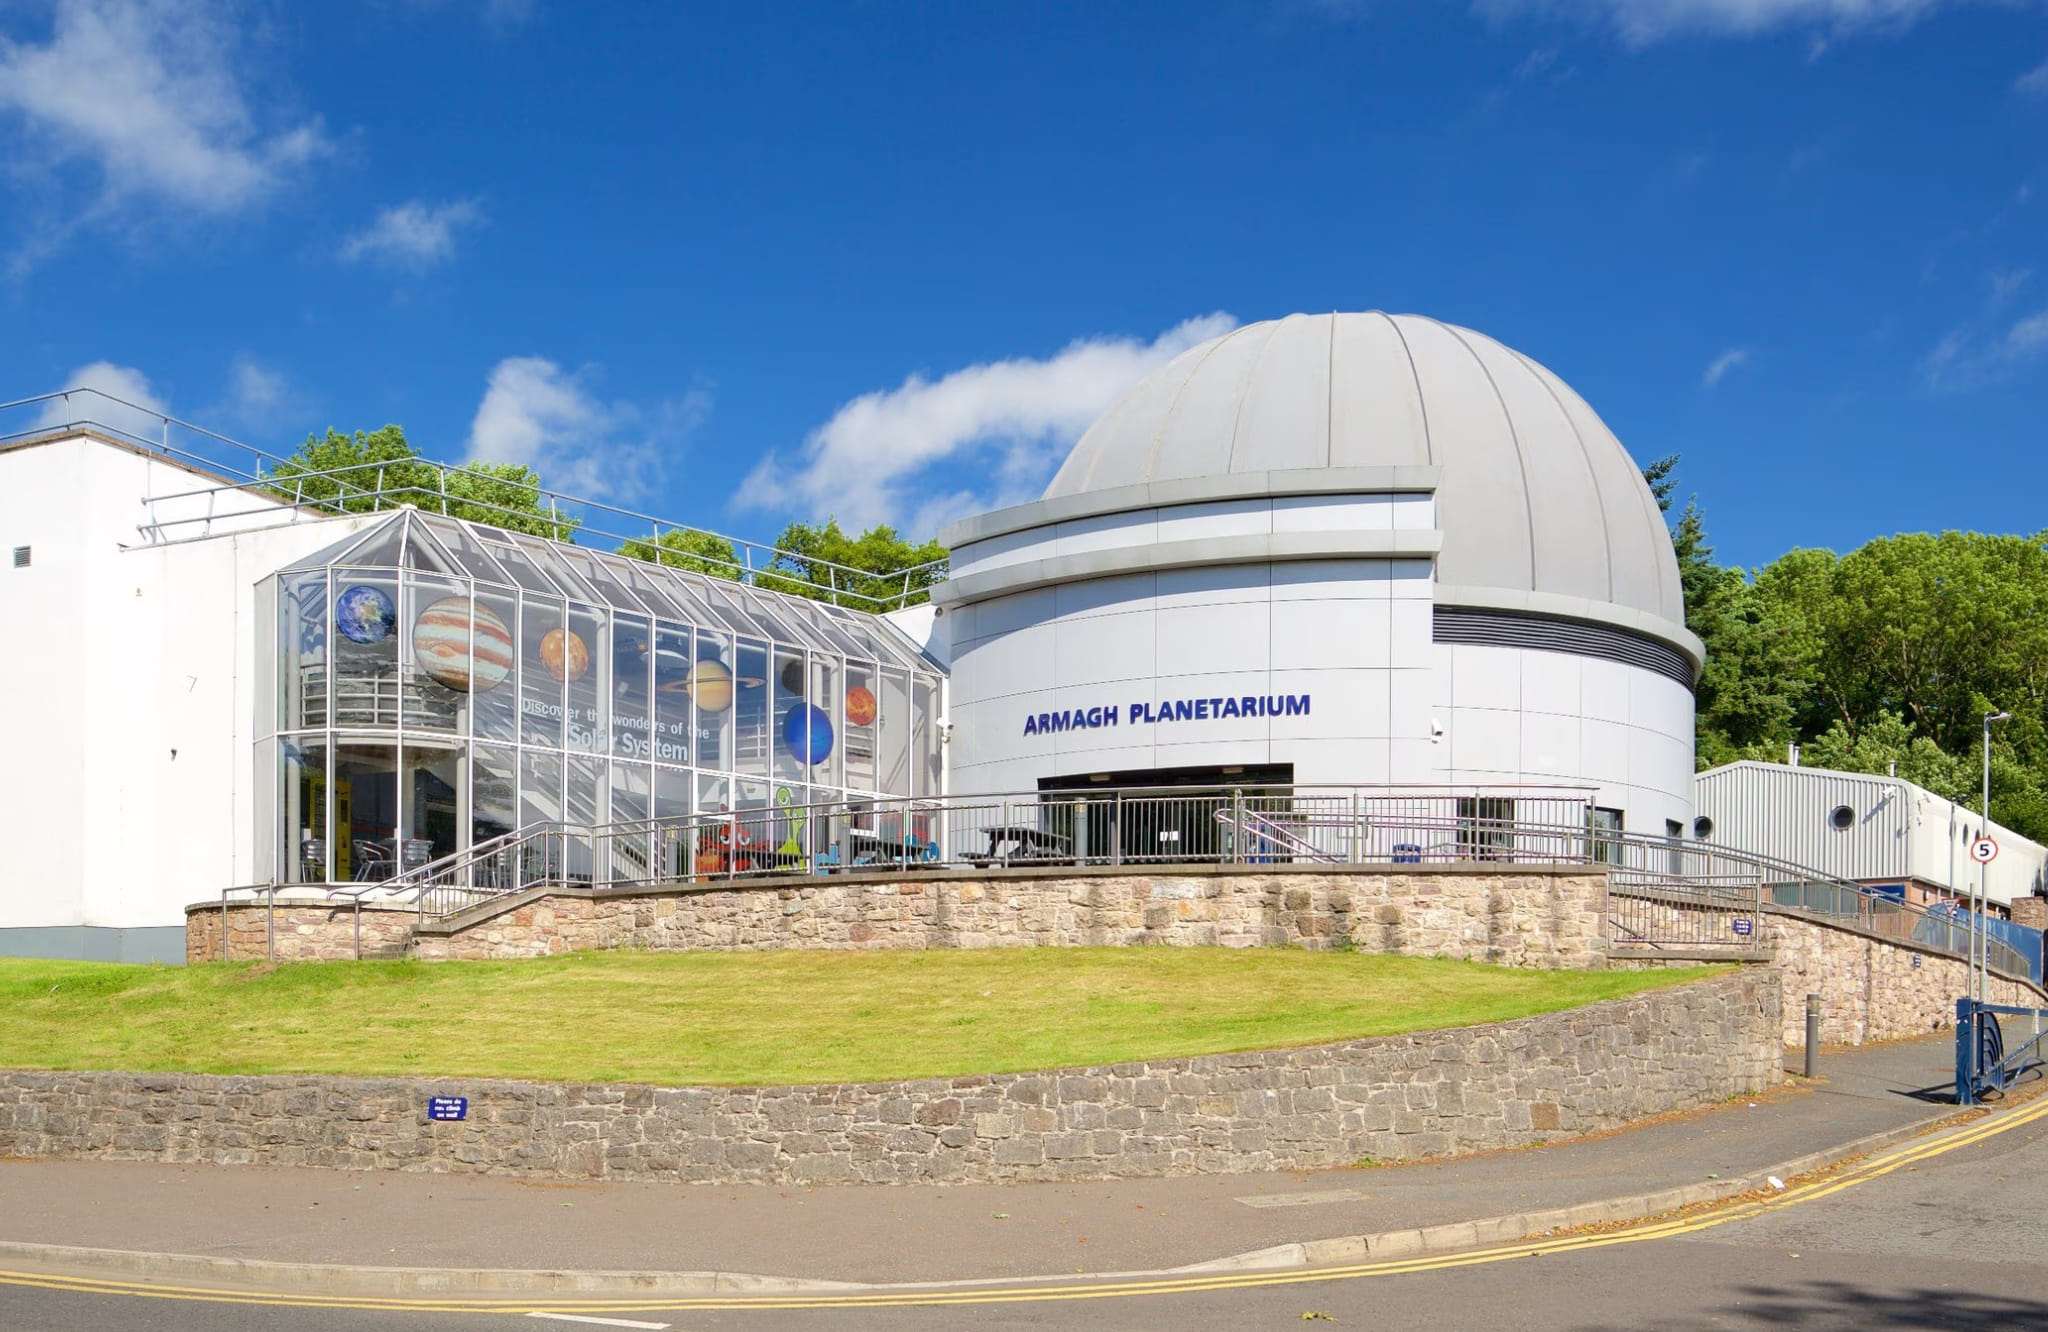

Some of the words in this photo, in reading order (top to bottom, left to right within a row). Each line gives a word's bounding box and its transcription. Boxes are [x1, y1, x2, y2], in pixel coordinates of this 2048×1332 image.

[522, 698, 580, 720] Discover
[671, 722, 683, 735] of
[1023, 705, 1118, 736] ARMAGH
[1129, 694, 1310, 724] PLANETARIUM
[568, 724, 618, 752] Solr
[622, 732, 688, 760] System
[1980, 844, 1990, 856] 5
